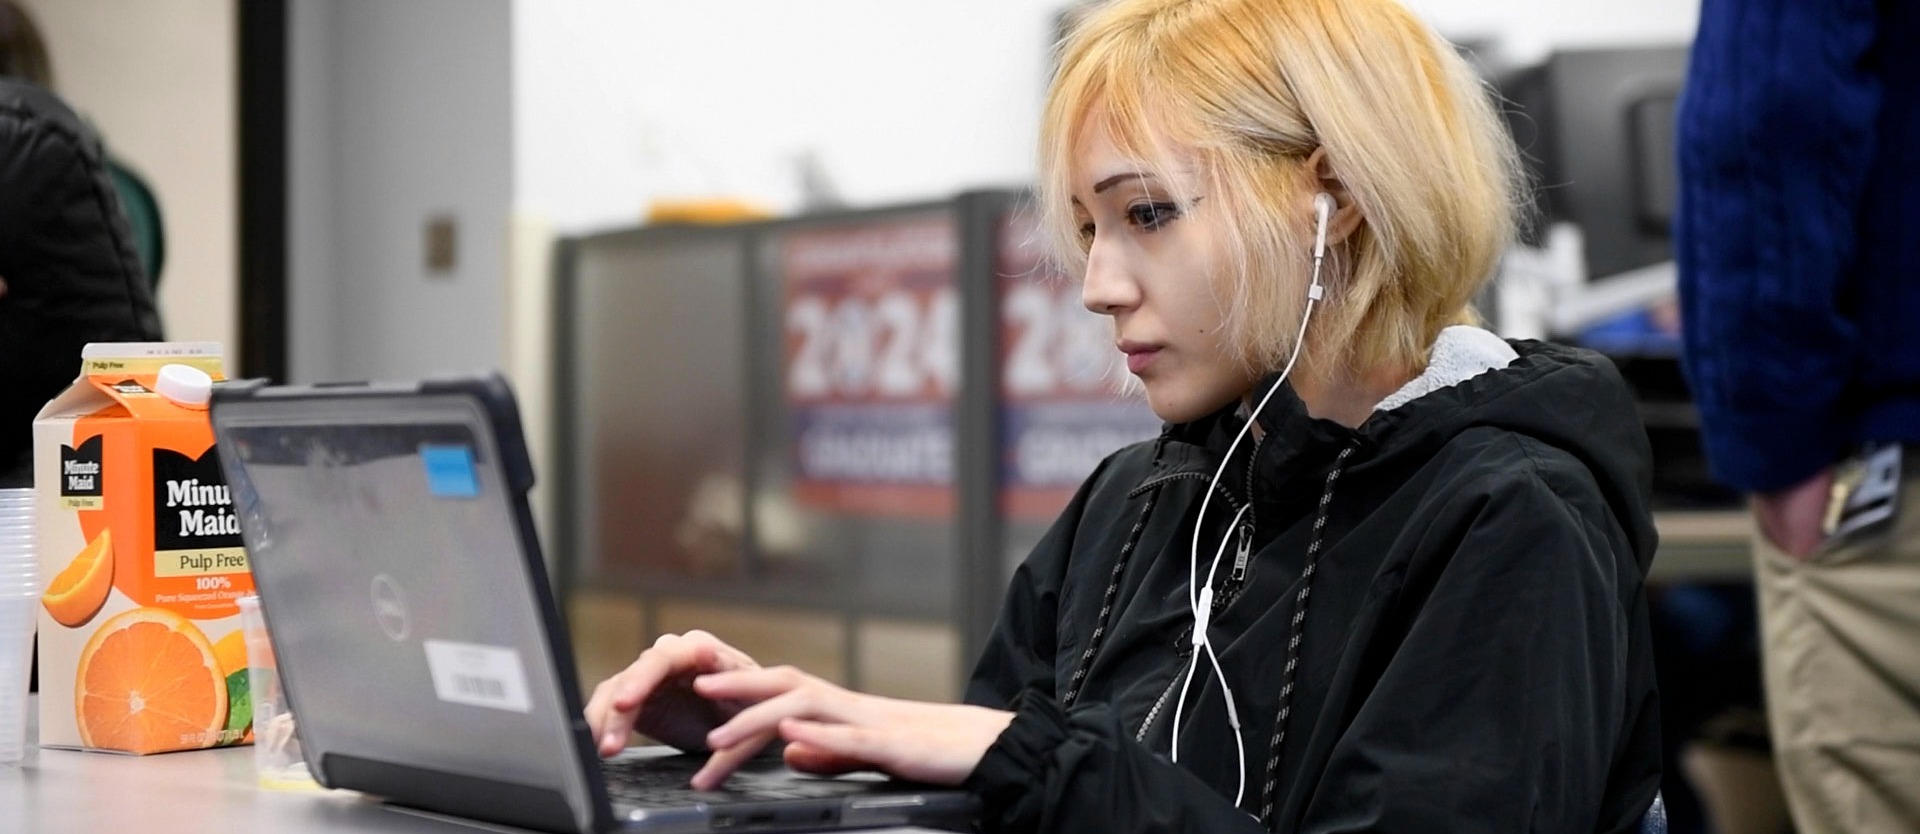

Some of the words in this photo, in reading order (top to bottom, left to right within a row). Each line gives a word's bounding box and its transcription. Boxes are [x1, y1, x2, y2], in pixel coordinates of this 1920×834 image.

[92, 361, 108, 370] Pulp
[110, 361, 124, 369] Free
[64, 460, 99, 475] Minute
[68, 475, 94, 490] Maid
[166, 478, 231, 507] Minu
[179, 507, 241, 536] Maid
[180, 553, 212, 571] Pulp
[216, 553, 245, 567] Free
[196, 576, 231, 590] 100%
